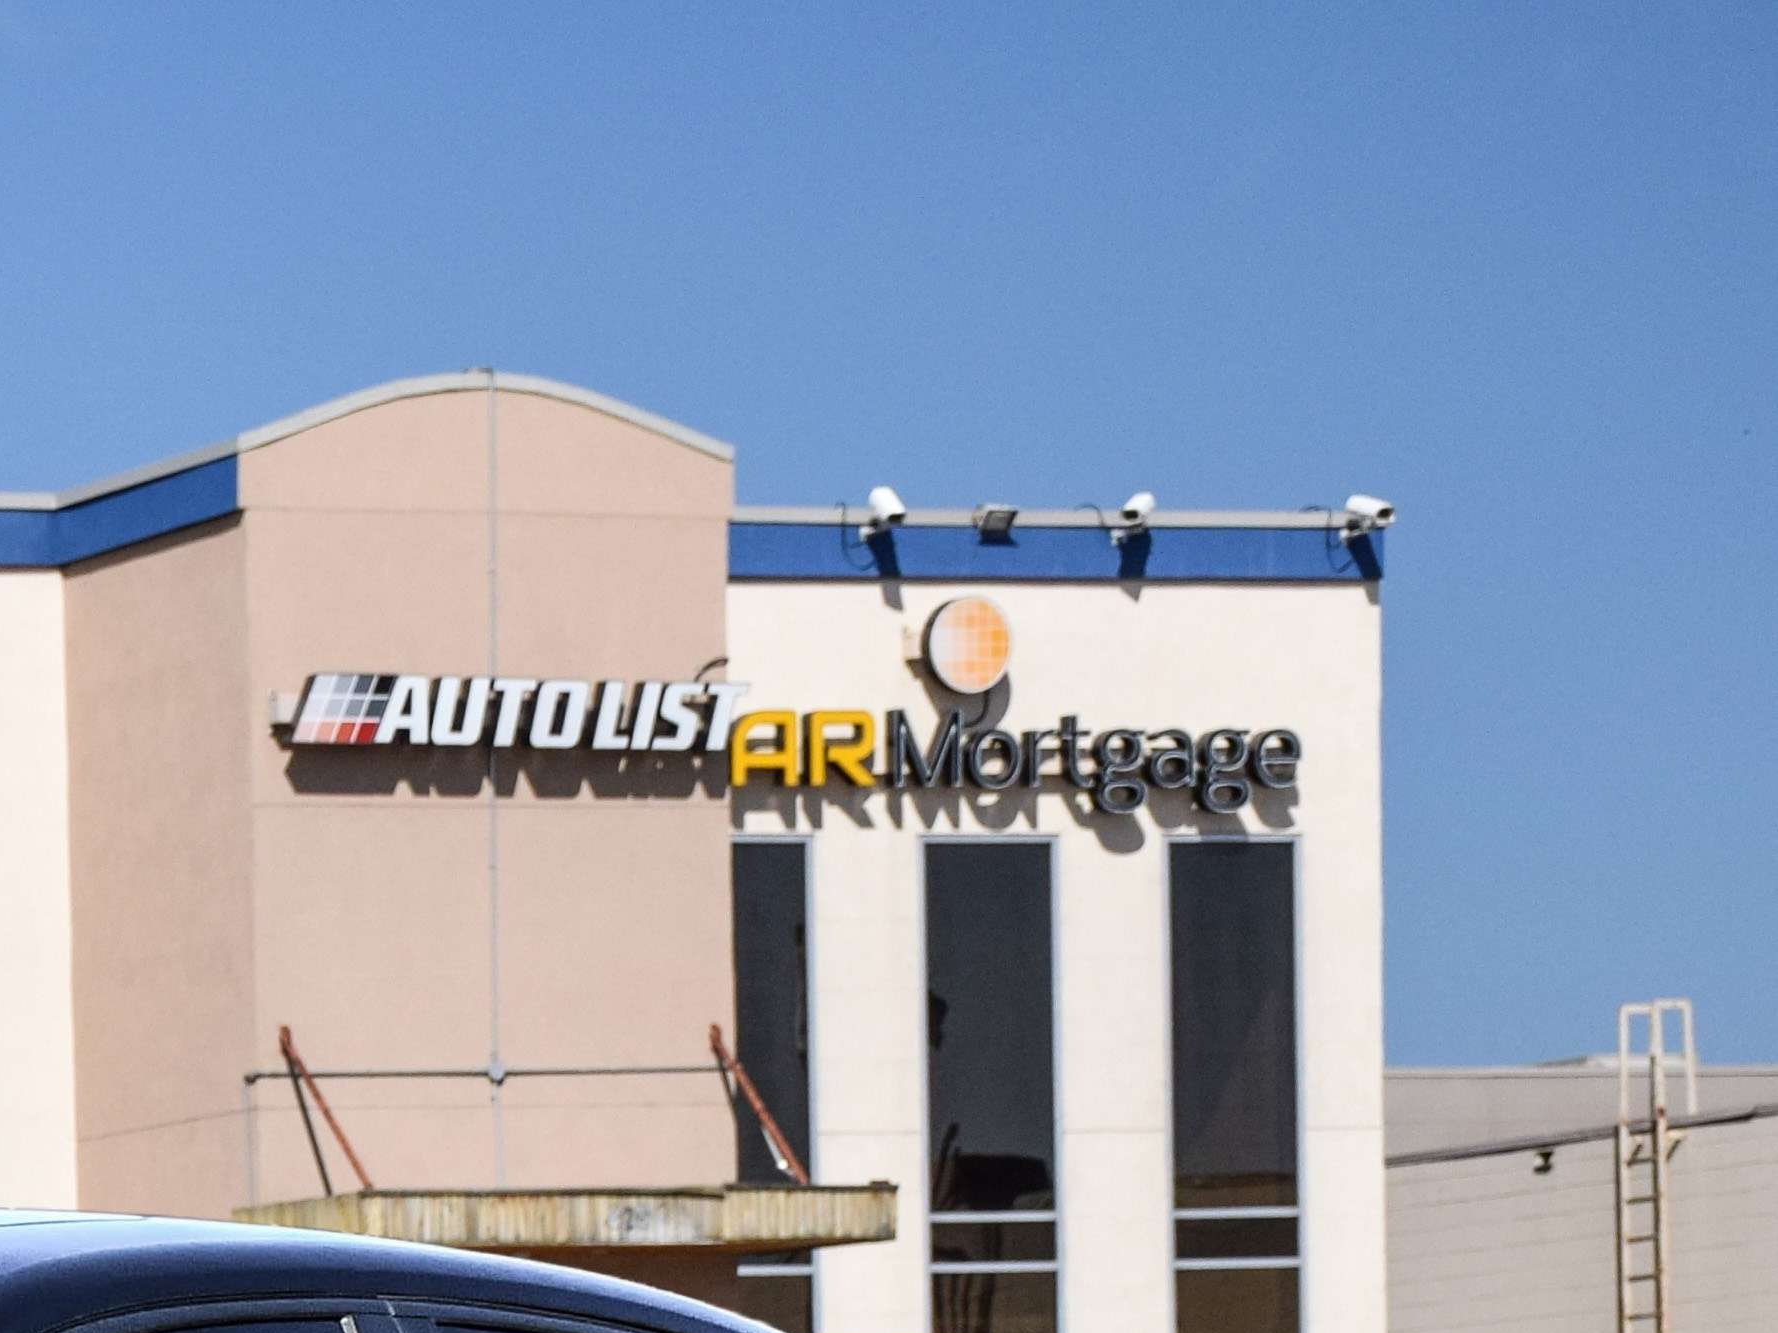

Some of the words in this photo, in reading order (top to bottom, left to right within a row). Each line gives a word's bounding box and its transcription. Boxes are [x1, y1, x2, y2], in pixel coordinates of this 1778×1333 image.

[374, 674, 591, 749] AUTO
[591, 680, 751, 753] LIST
[731, 709, 877, 789] AR
[885, 708, 1303, 815] Mortgage
